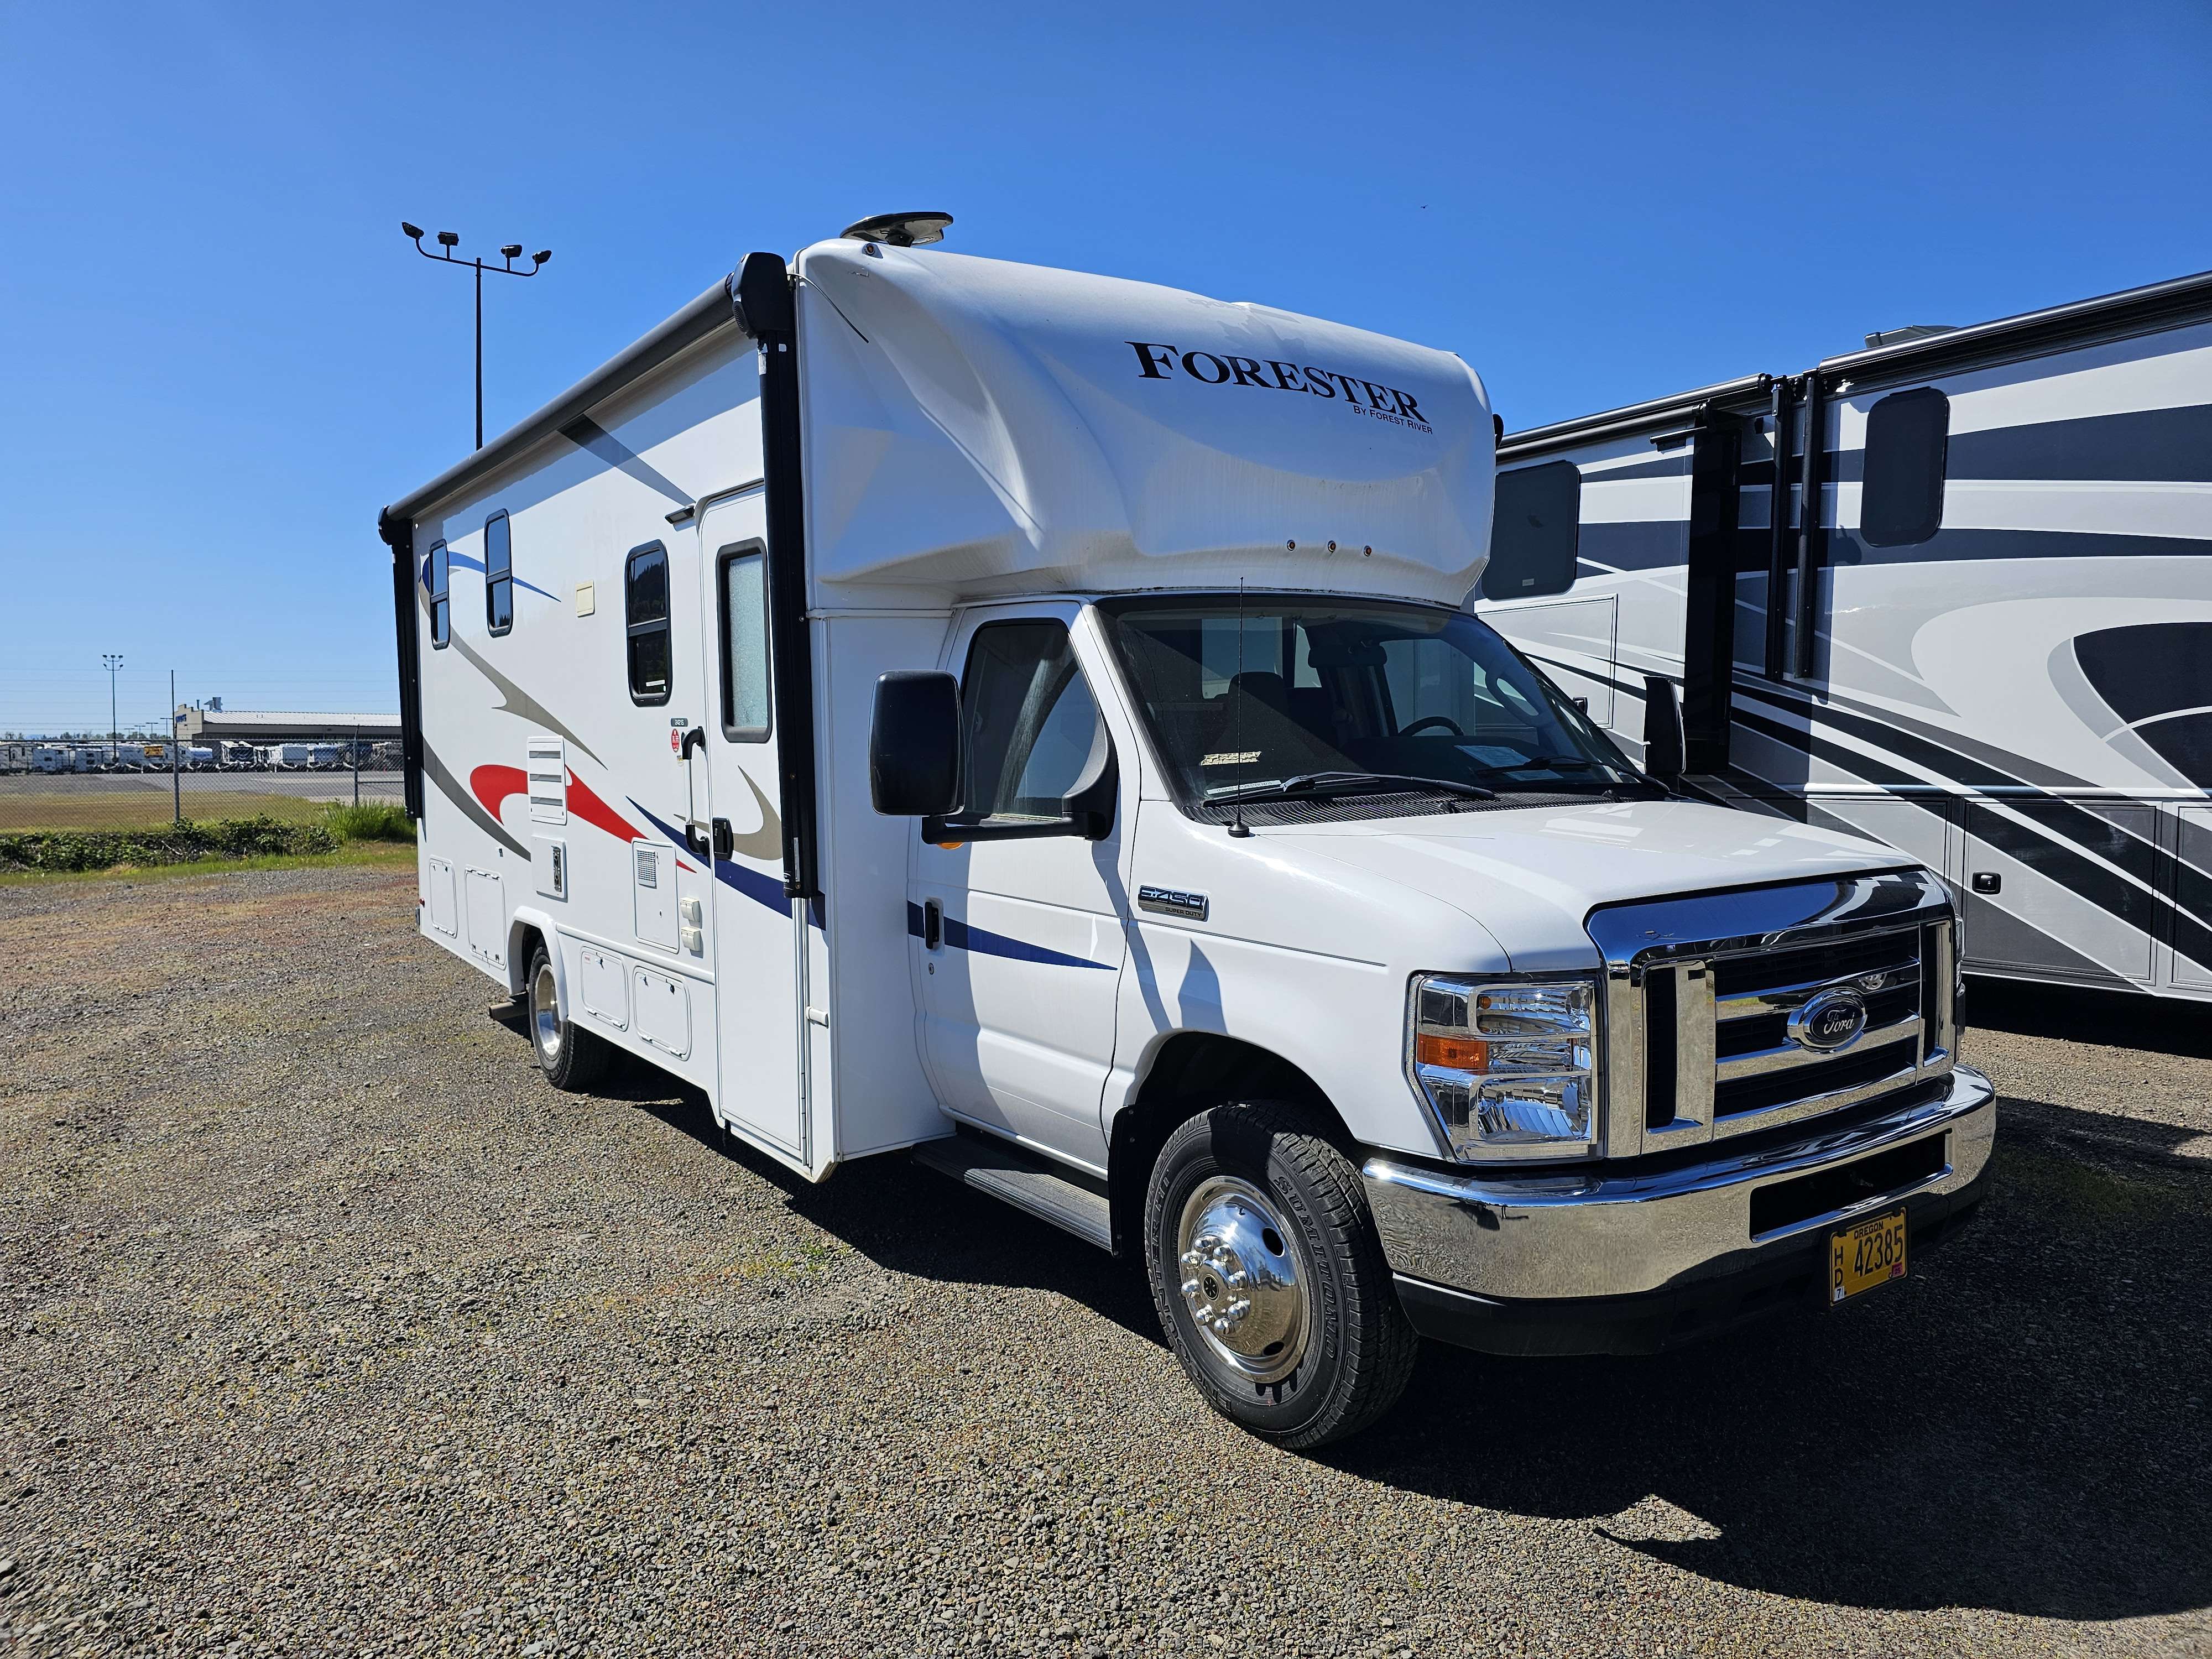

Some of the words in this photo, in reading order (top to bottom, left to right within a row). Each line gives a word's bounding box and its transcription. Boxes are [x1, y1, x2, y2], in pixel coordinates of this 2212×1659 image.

[1124, 341, 1429, 424] FORESTER
[1353, 405, 1366, 415] BY
[1369, 409, 1405, 426] FOREST
[1407, 419, 1433, 434] RIVER
[1823, 1008, 1855, 1035] Ford
[1854, 1221, 1884, 1239] OREGON
[1854, 1224, 1903, 1277] 42385
[1274, 1176, 1338, 1360] SUMITOMO
[1837, 1288, 1841, 1298] 7
[1152, 1219, 1232, 1412] ENCOUNTER
